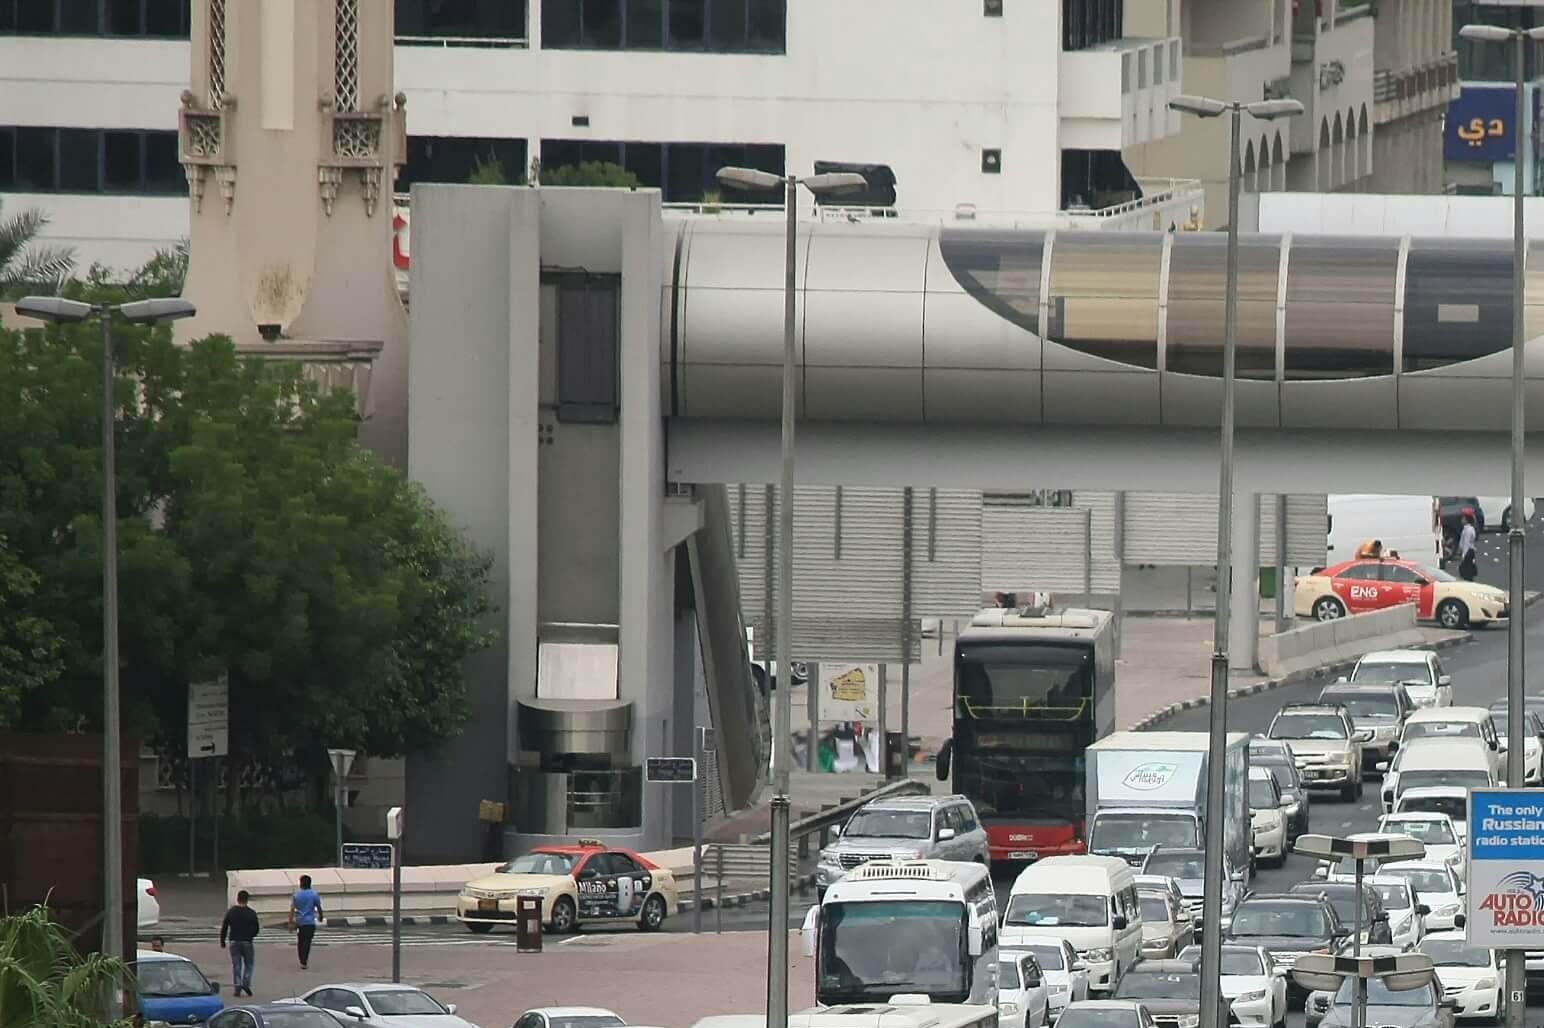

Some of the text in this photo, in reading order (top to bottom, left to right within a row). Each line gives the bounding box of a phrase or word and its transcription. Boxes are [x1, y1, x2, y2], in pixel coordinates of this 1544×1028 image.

[1351, 586, 1378, 598] ENG
[1488, 804, 1544, 819] The only
[1475, 835, 1509, 847] radio
[1478, 893, 1533, 911] AUTO
[1512, 991, 1524, 1002] 61
